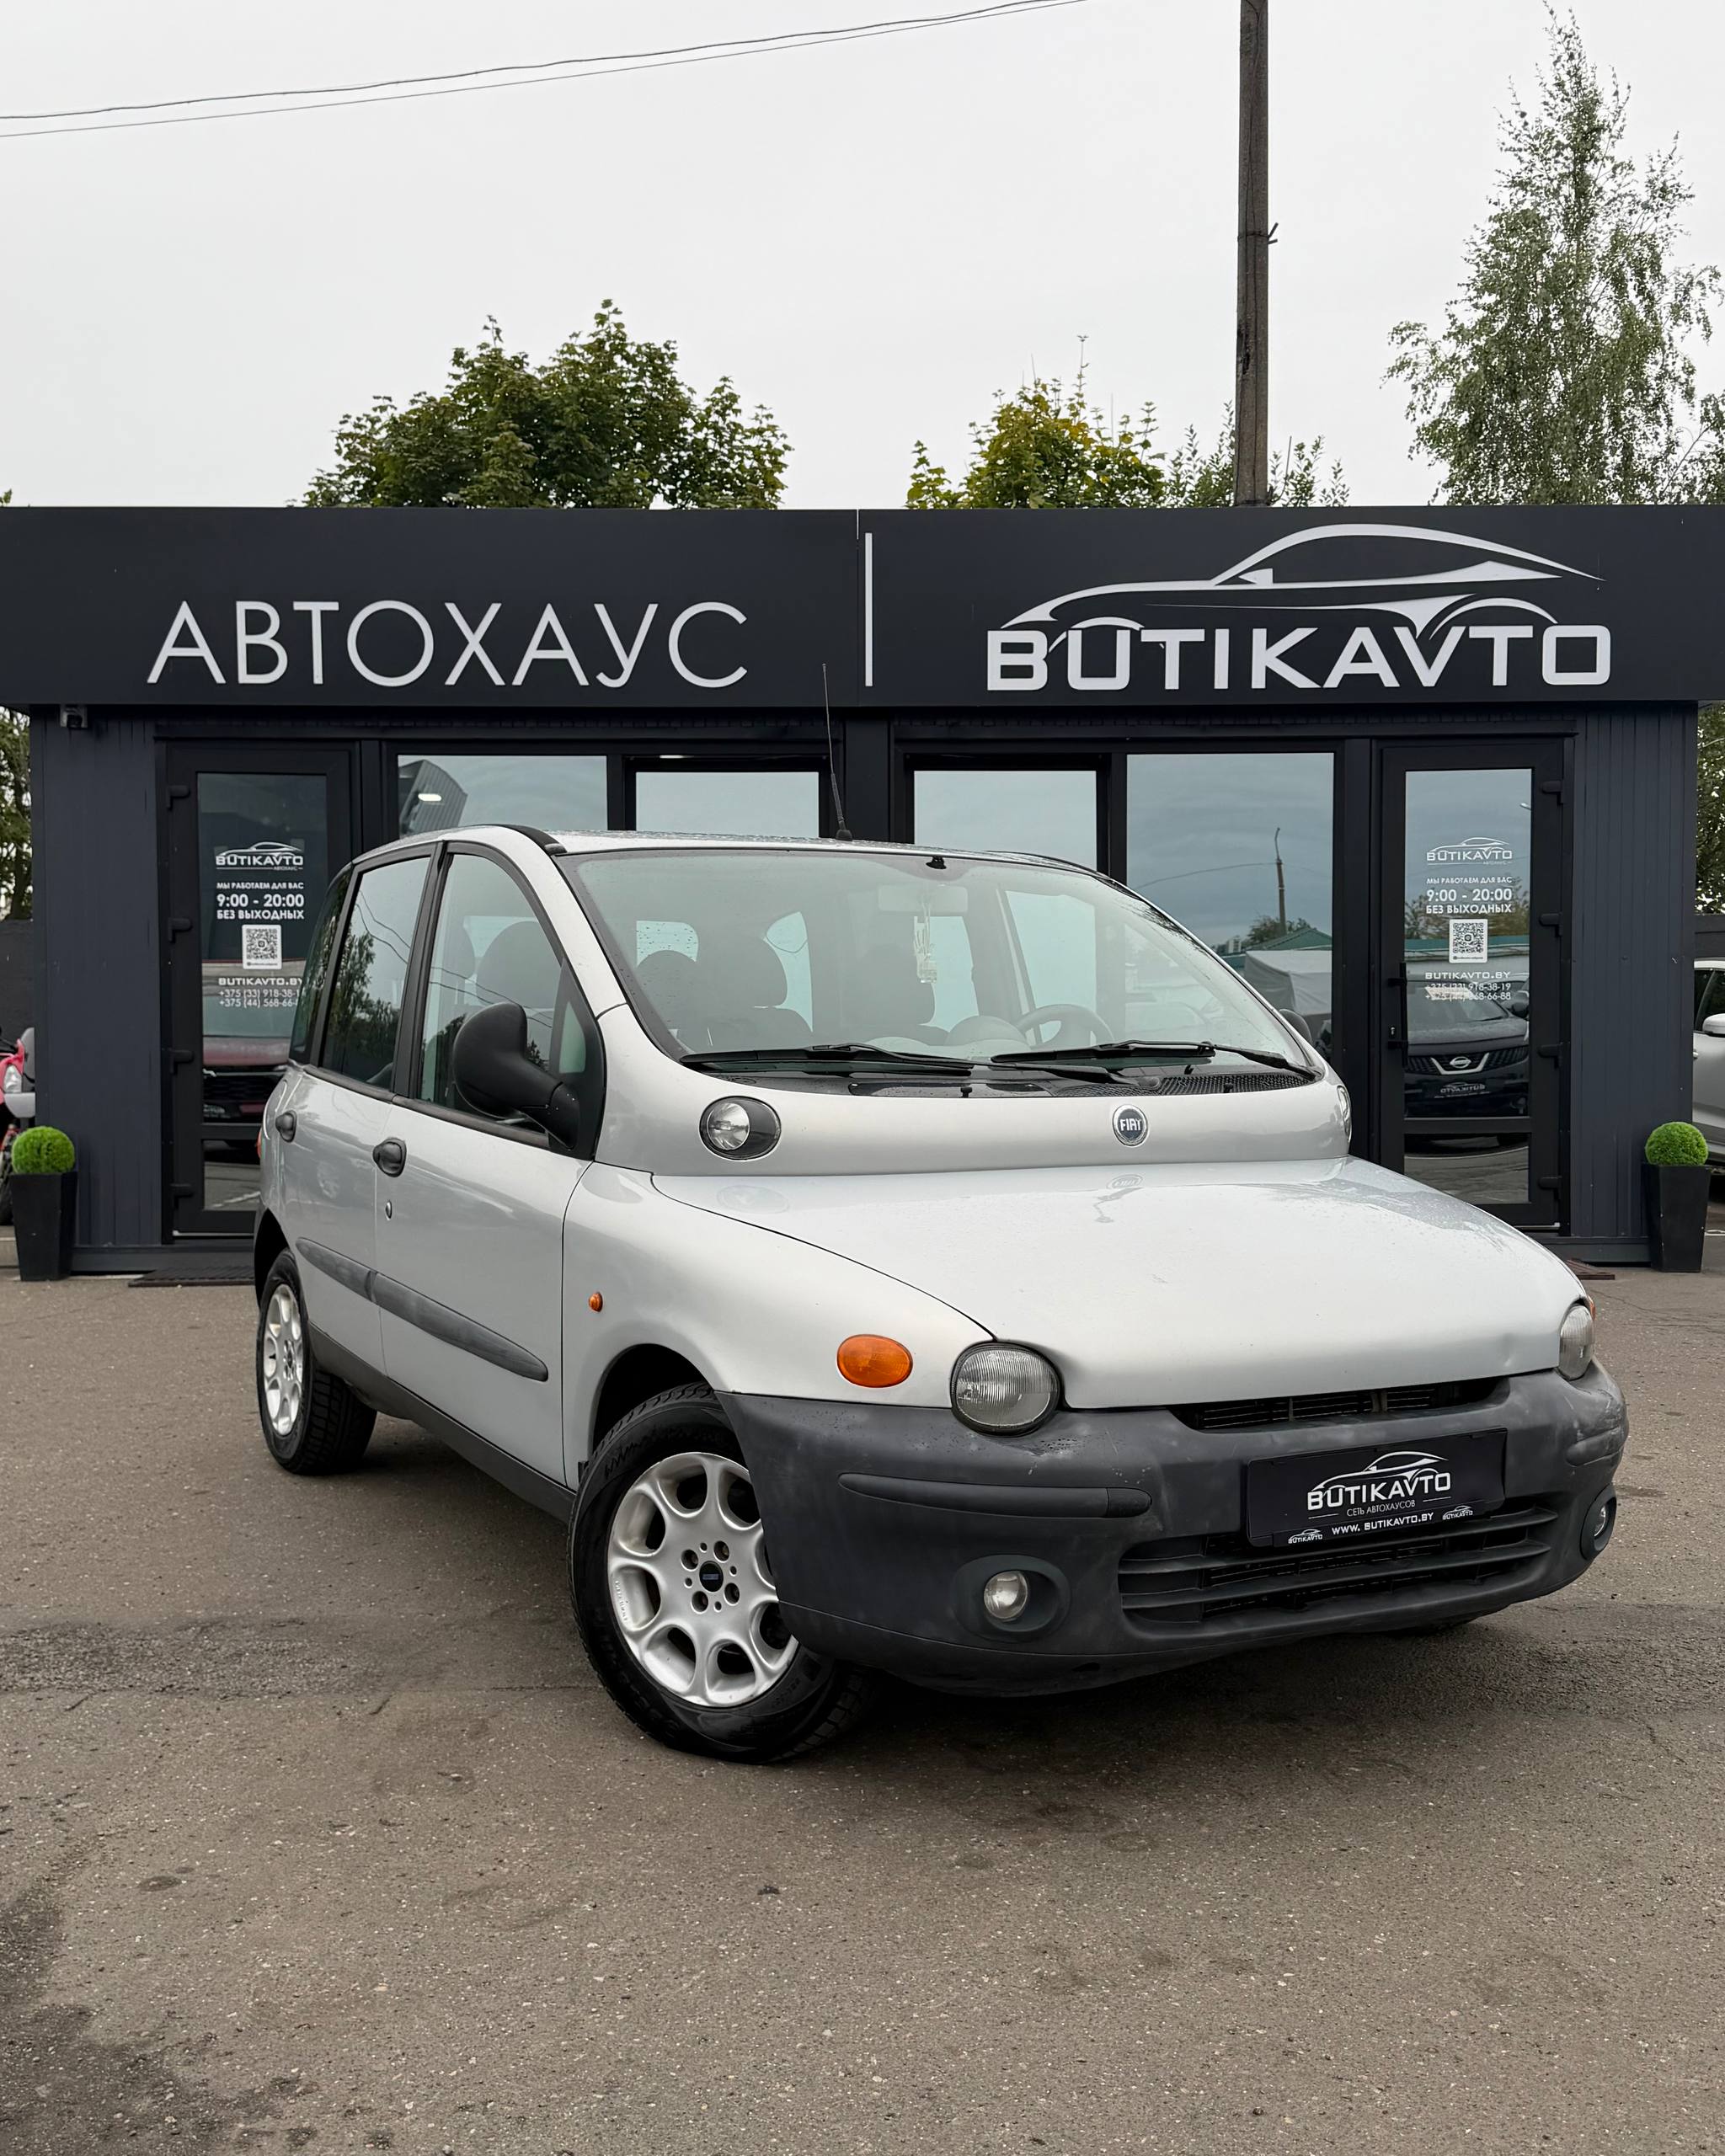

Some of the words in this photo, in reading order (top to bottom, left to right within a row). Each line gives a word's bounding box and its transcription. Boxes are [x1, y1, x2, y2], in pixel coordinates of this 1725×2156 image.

[147, 600, 748, 689] АВТОХАУС
[987, 624, 1611, 691] BUTIKAVTO
[216, 856, 303, 866] BUTIKAVTO
[1426, 851, 1513, 861] BUTIKAVTO
[271, 882, 286, 890] ДЛЯ
[216, 894, 248, 907] 9:00
[263, 894, 305, 907] 20:00
[1426, 889, 1457, 902] 9:00
[1472, 889, 1513, 901] 20:00
[1426, 905, 1444, 914] БЕЗ
[1447, 904, 1512, 915] ВЫХОДНЫХ
[216, 910, 235, 919] БЕЗ
[238, 910, 305, 921] ВЫХОДНЫХ
[1425, 971, 1511, 979] BUTIKAVTO.BY
[1468, 983, 1511, 991] 918-38-19
[219, 989, 241, 997] +375
[243, 989, 260, 999] (33)
[263, 989, 301, 997] 918-38-1
[219, 998, 241, 1006] +375
[243, 998, 260, 1008] (44)
[263, 998, 298, 1006] 568-66-
[1119, 1118, 1142, 1131] FIAT
[1307, 1472, 1451, 1511] BUTIKAVTO
[1347, 1508, 1365, 1517] СЕТЬ
[1366, 1499, 1416, 1514] АВТОХАУСОВ
[1332, 1524, 1360, 1535] WWW.
[1364, 1512, 1434, 1530] BUTIKAVTO.BY
